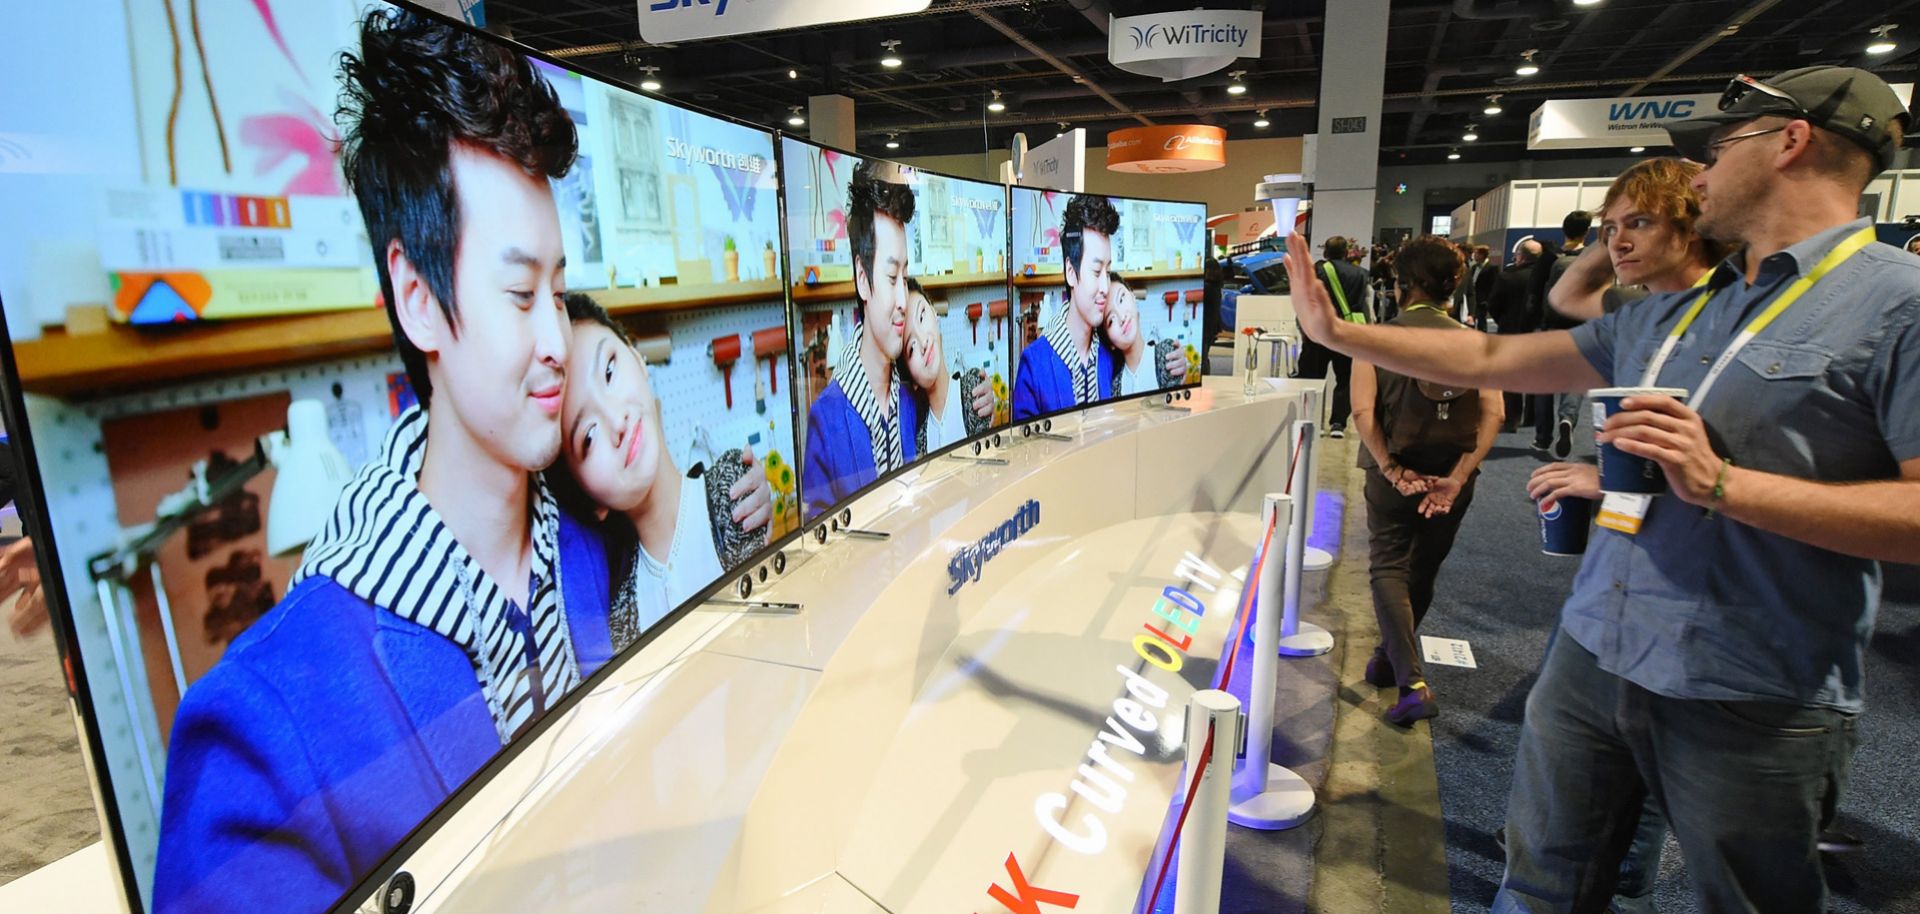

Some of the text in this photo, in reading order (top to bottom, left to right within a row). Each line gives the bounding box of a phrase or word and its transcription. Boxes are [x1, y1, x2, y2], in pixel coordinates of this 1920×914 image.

[1163, 23, 1248, 48] WiTricity
[1609, 100, 1695, 121] WNC
[1607, 123, 1637, 131] Wistron
[666, 137, 737, 169] Skyworth
[947, 498, 1041, 596] Skyworth
[974, 550, 1222, 914] K Curved OLED TV
